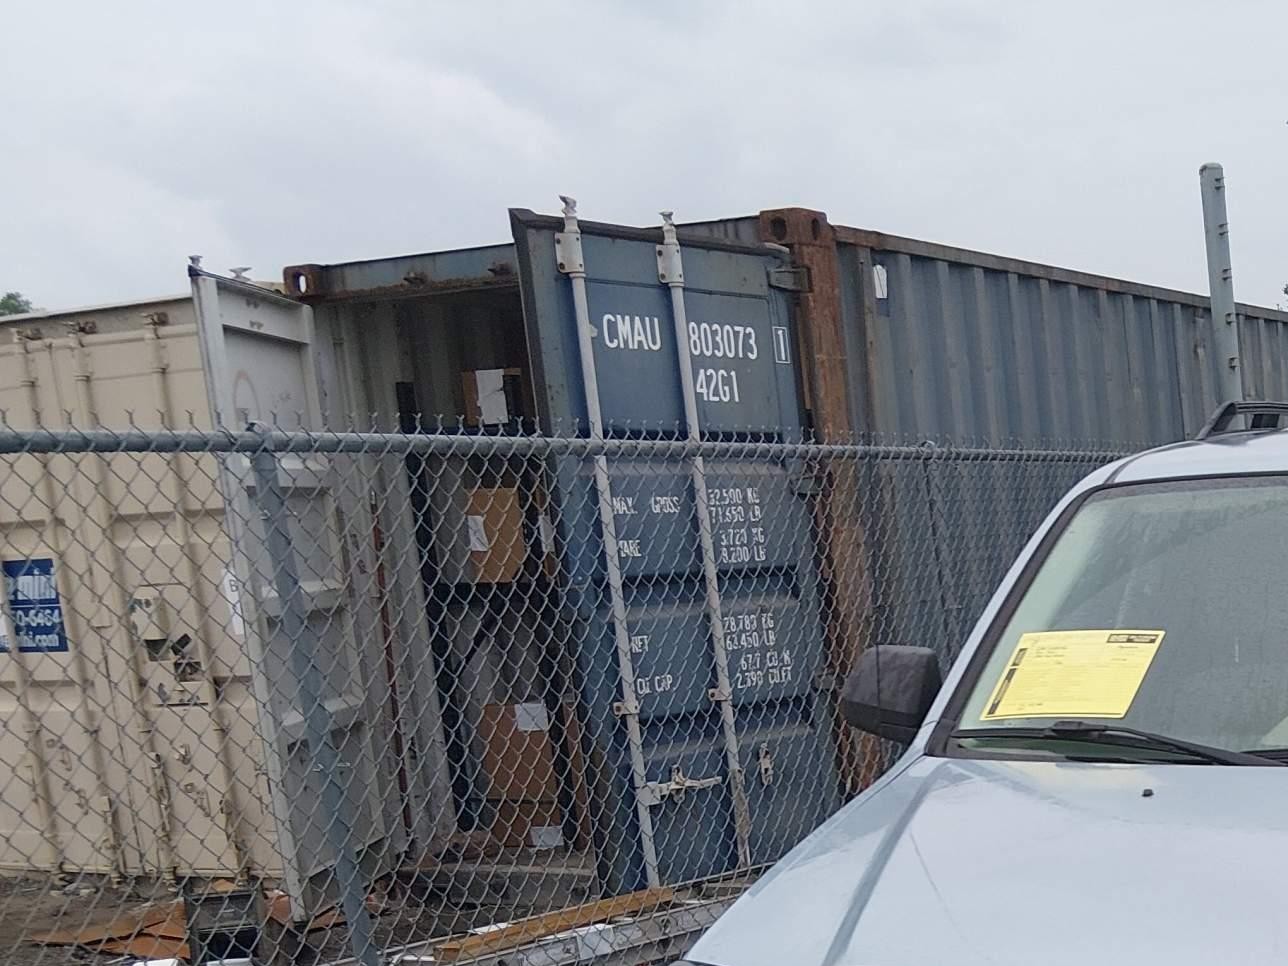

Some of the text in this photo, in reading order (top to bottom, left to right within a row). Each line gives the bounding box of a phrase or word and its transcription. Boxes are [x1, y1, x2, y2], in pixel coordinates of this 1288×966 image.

[603, 313, 788, 362] CMAU 803073 1
[696, 368, 740, 402] 42G1
[746, 487, 760, 504] KG
[651, 496, 680, 513] GROSS
[750, 505, 762, 521] LB
[752, 527, 765, 543] KG
[619, 540, 642, 557] TARE
[754, 545, 767, 561] LB
[761, 612, 774, 628] KG
[631, 635, 649, 653] NET
[764, 630, 776, 646] LB
